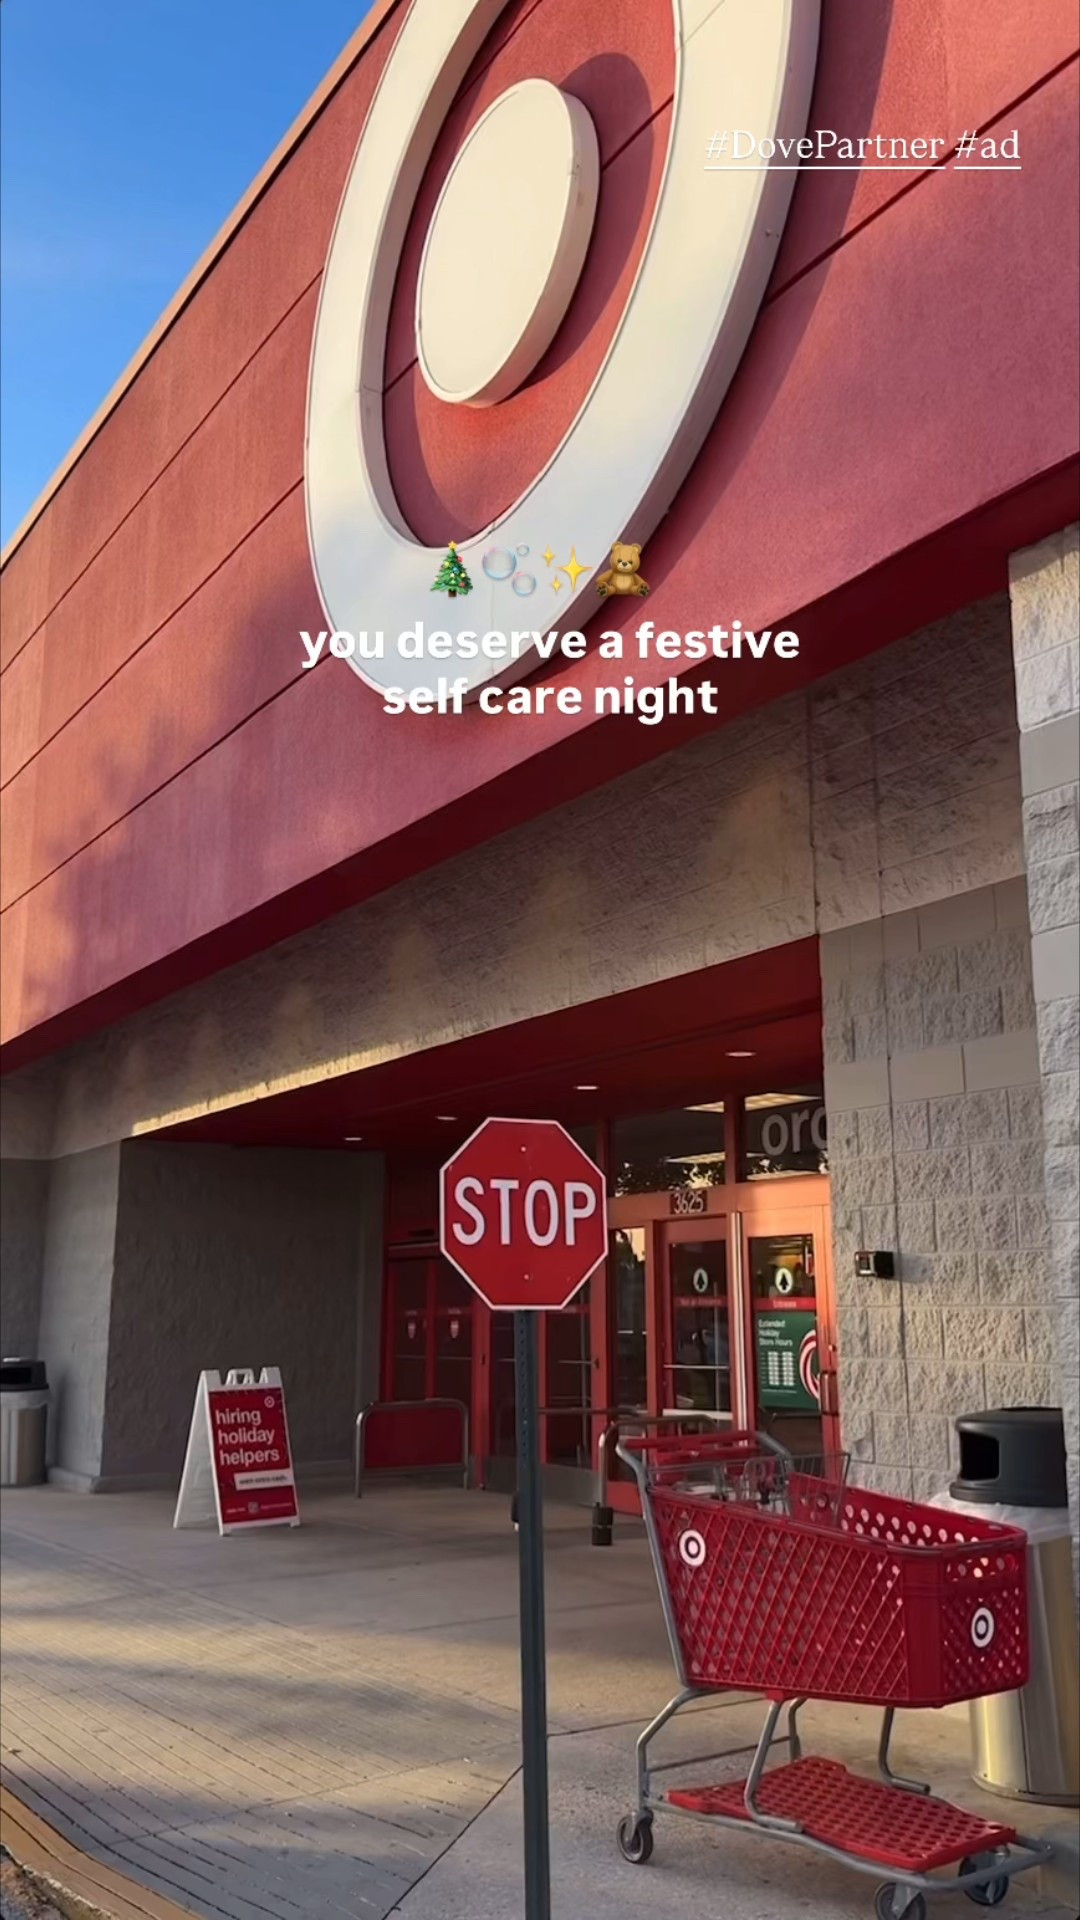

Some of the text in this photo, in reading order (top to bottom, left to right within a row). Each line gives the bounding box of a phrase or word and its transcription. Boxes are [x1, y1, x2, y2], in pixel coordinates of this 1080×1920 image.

[452, 1176, 597, 1247] STOP
[673, 1191, 704, 1215] 3625
[215, 1408, 261, 1426] hiring
[218, 1427, 275, 1446] holiday
[219, 1447, 280, 1468] helpers
